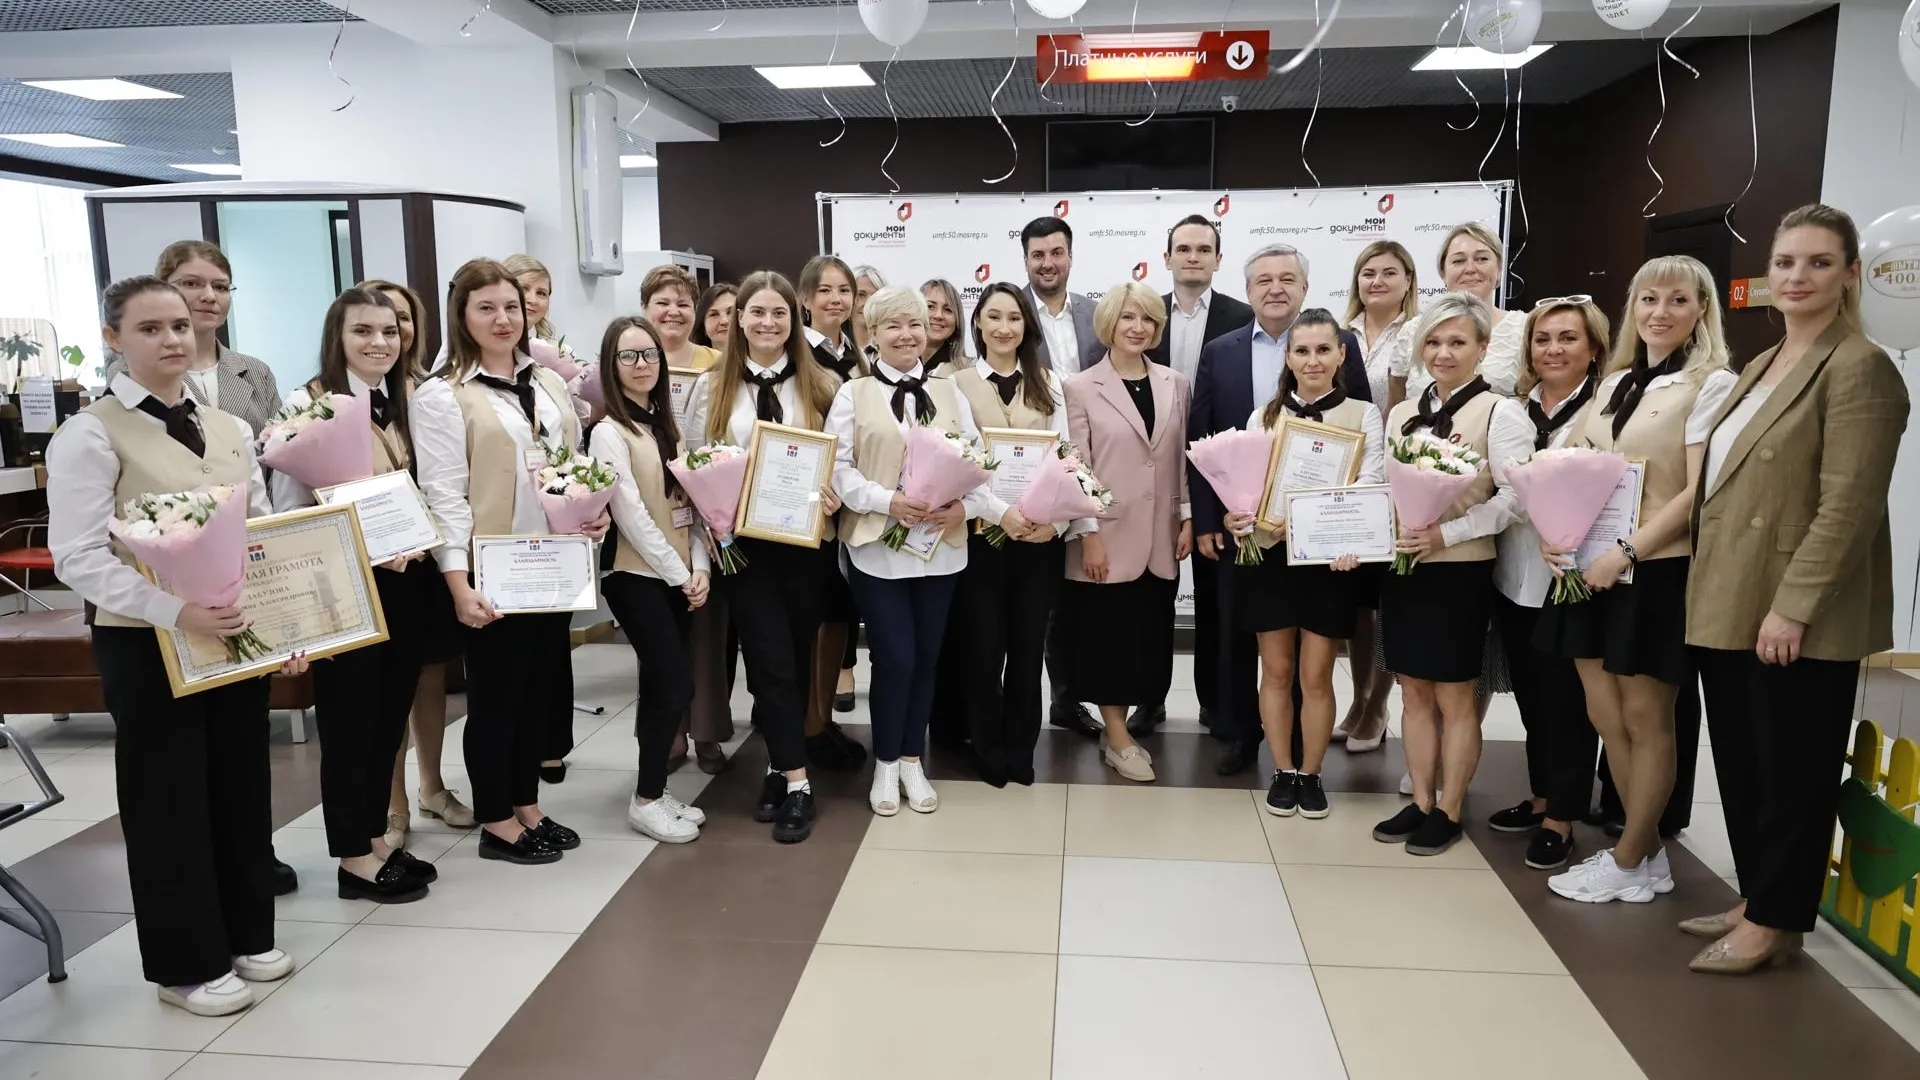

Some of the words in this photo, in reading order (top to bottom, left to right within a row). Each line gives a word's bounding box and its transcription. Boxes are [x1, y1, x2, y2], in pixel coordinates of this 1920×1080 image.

[1055, 49, 1137, 67] Платные
[1143, 50, 1207, 66] услуги
[932, 231, 988, 241] umfc50.mosreg.ru
[1089, 229, 1147, 239] umfc50.mosreg.ru
[1249, 226, 1308, 236] umfc50.mosreg.ru
[1733, 286, 1745, 301] 02
[269, 556, 324, 576] ГРАМОТА
